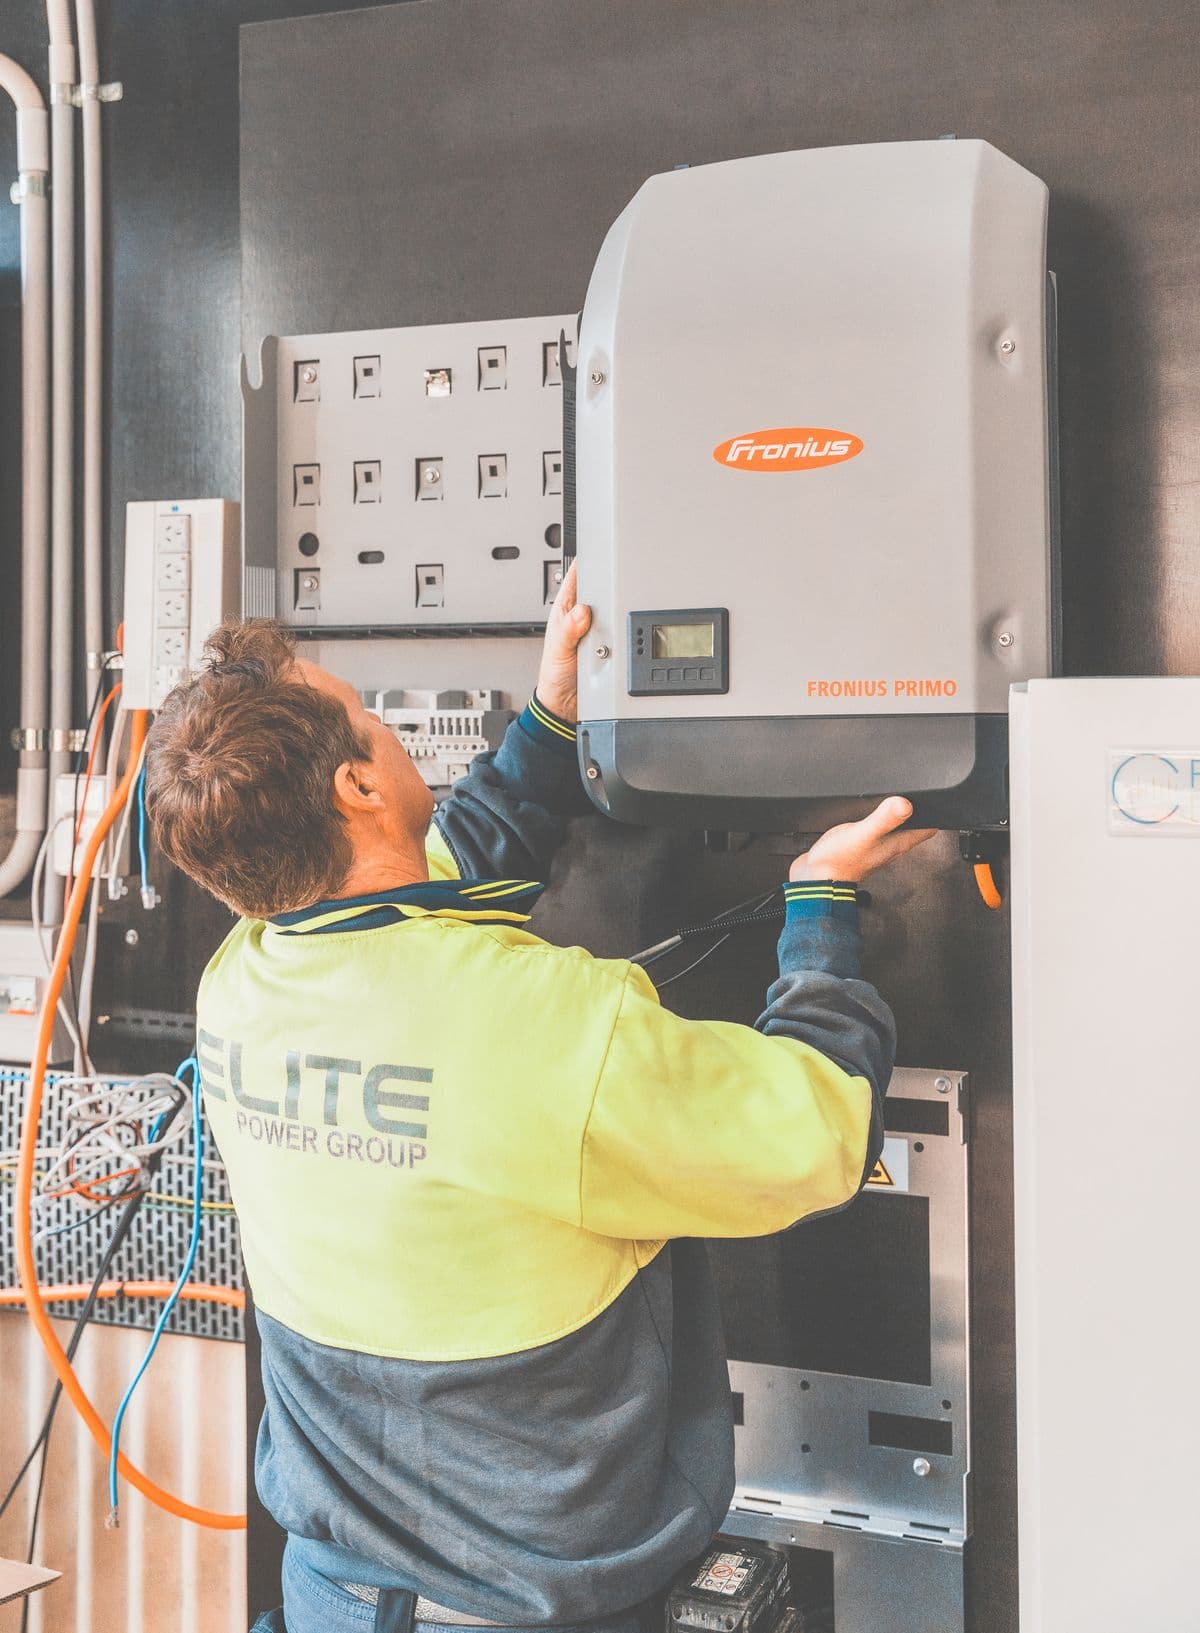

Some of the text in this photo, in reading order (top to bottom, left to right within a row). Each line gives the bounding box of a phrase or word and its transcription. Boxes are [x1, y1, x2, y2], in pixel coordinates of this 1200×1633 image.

[726, 437, 852, 462] Fronius
[807, 679, 957, 697] FRONIUS PRIMO
[199, 1028, 434, 1139] ELITE
[236, 1111, 427, 1169] POWER GROUP
